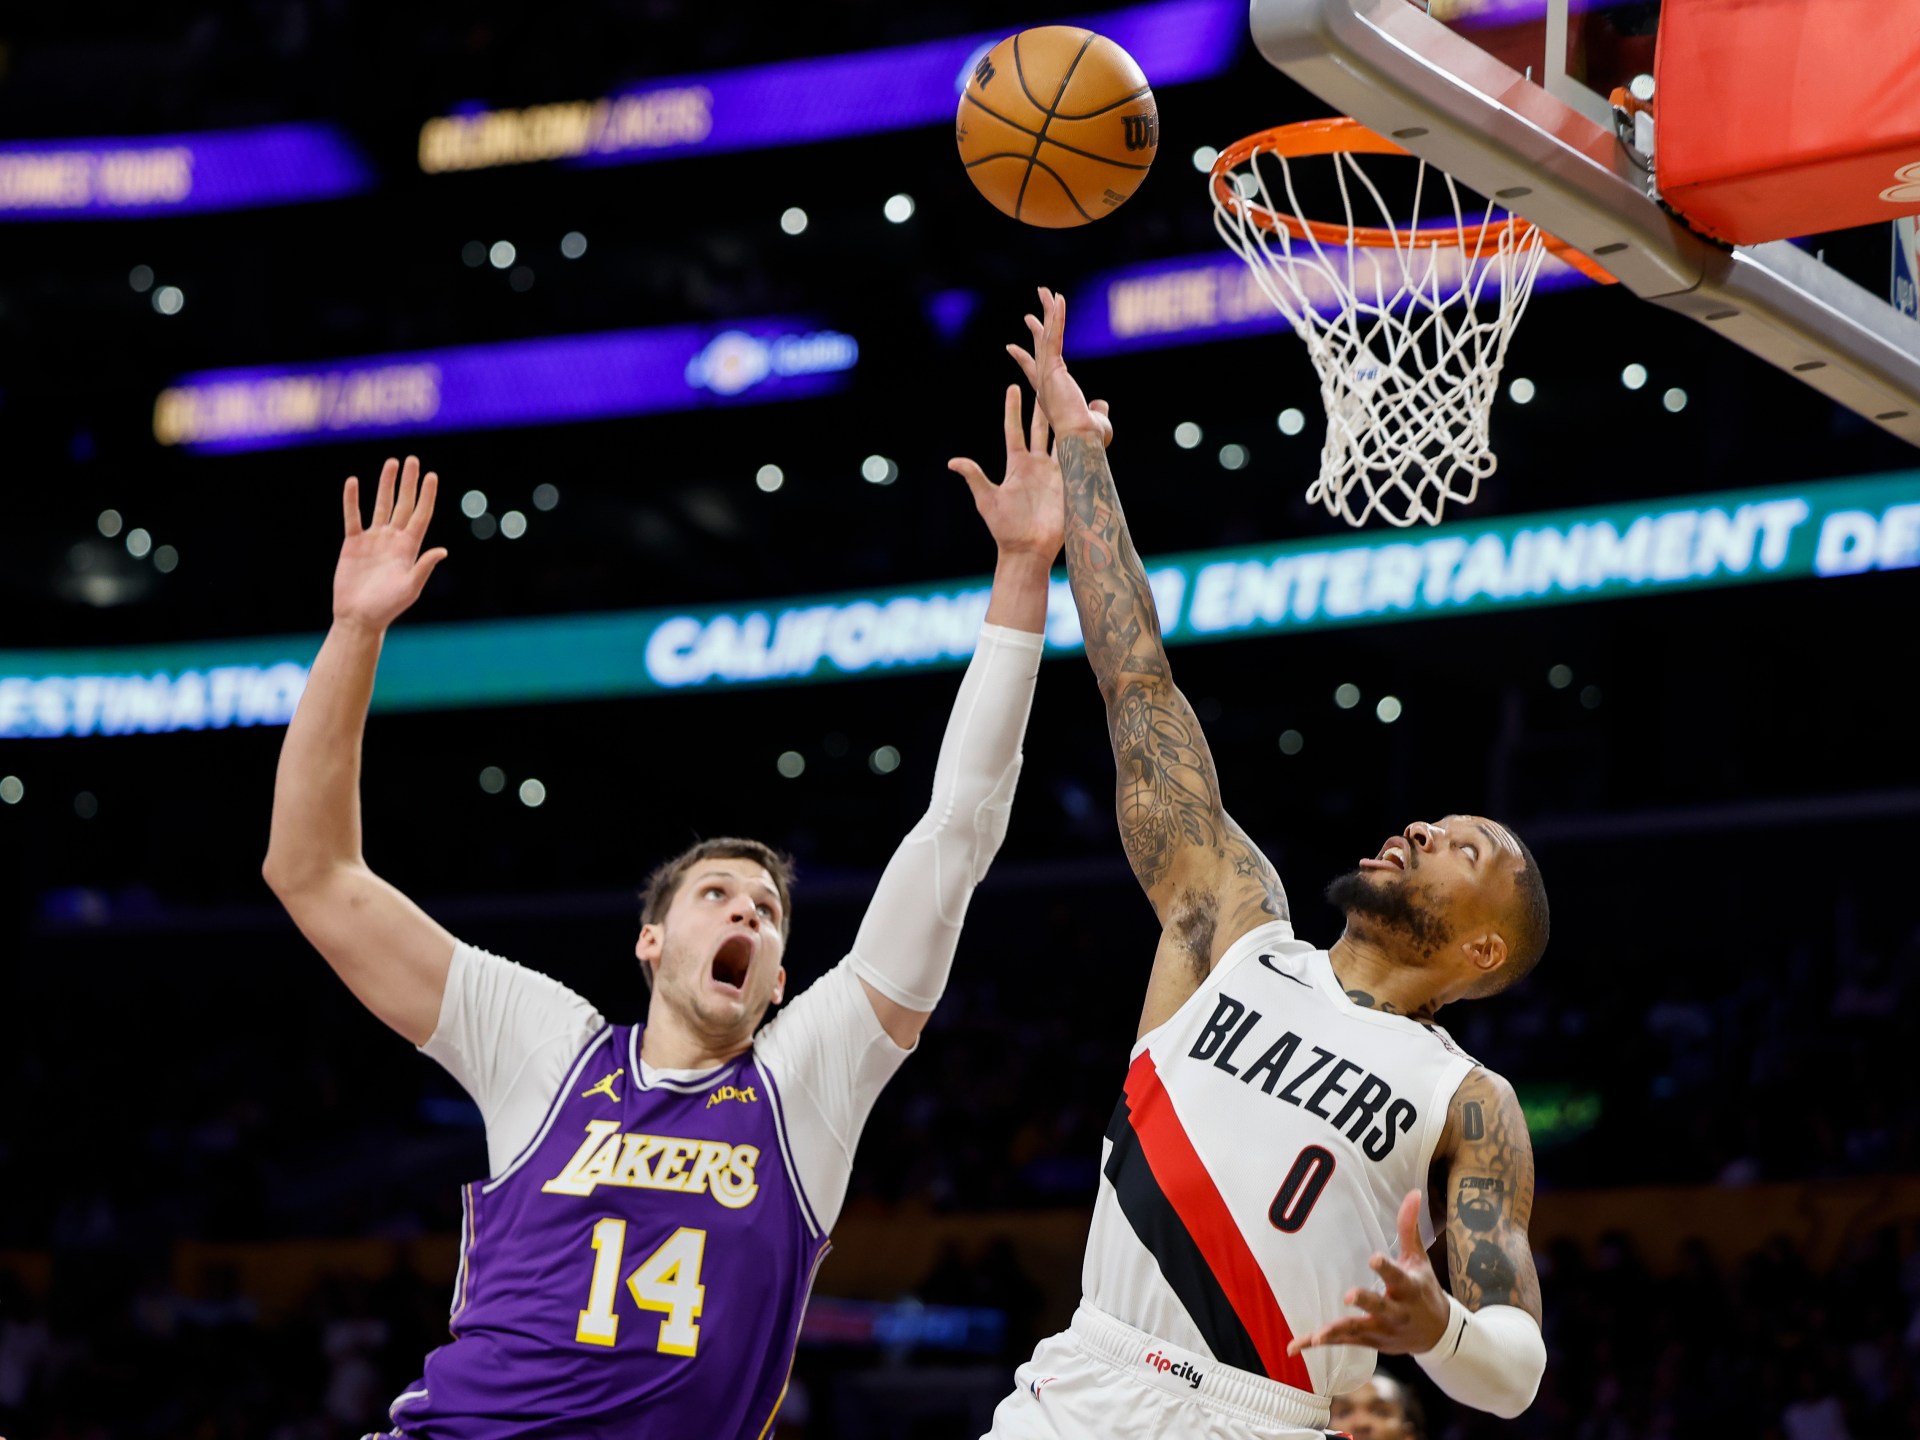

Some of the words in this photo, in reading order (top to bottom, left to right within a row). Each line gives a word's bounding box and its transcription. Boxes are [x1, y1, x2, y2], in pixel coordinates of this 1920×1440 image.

[1189, 497, 1809, 635] ENTERTAINMENT
[1188, 992, 1417, 1162] BLAZERS
[541, 1119, 760, 1209] LAKERS
[1268, 1144, 1336, 1234] 0
[575, 1217, 707, 1358] 14
[1145, 1350, 1203, 1389] ripcity
